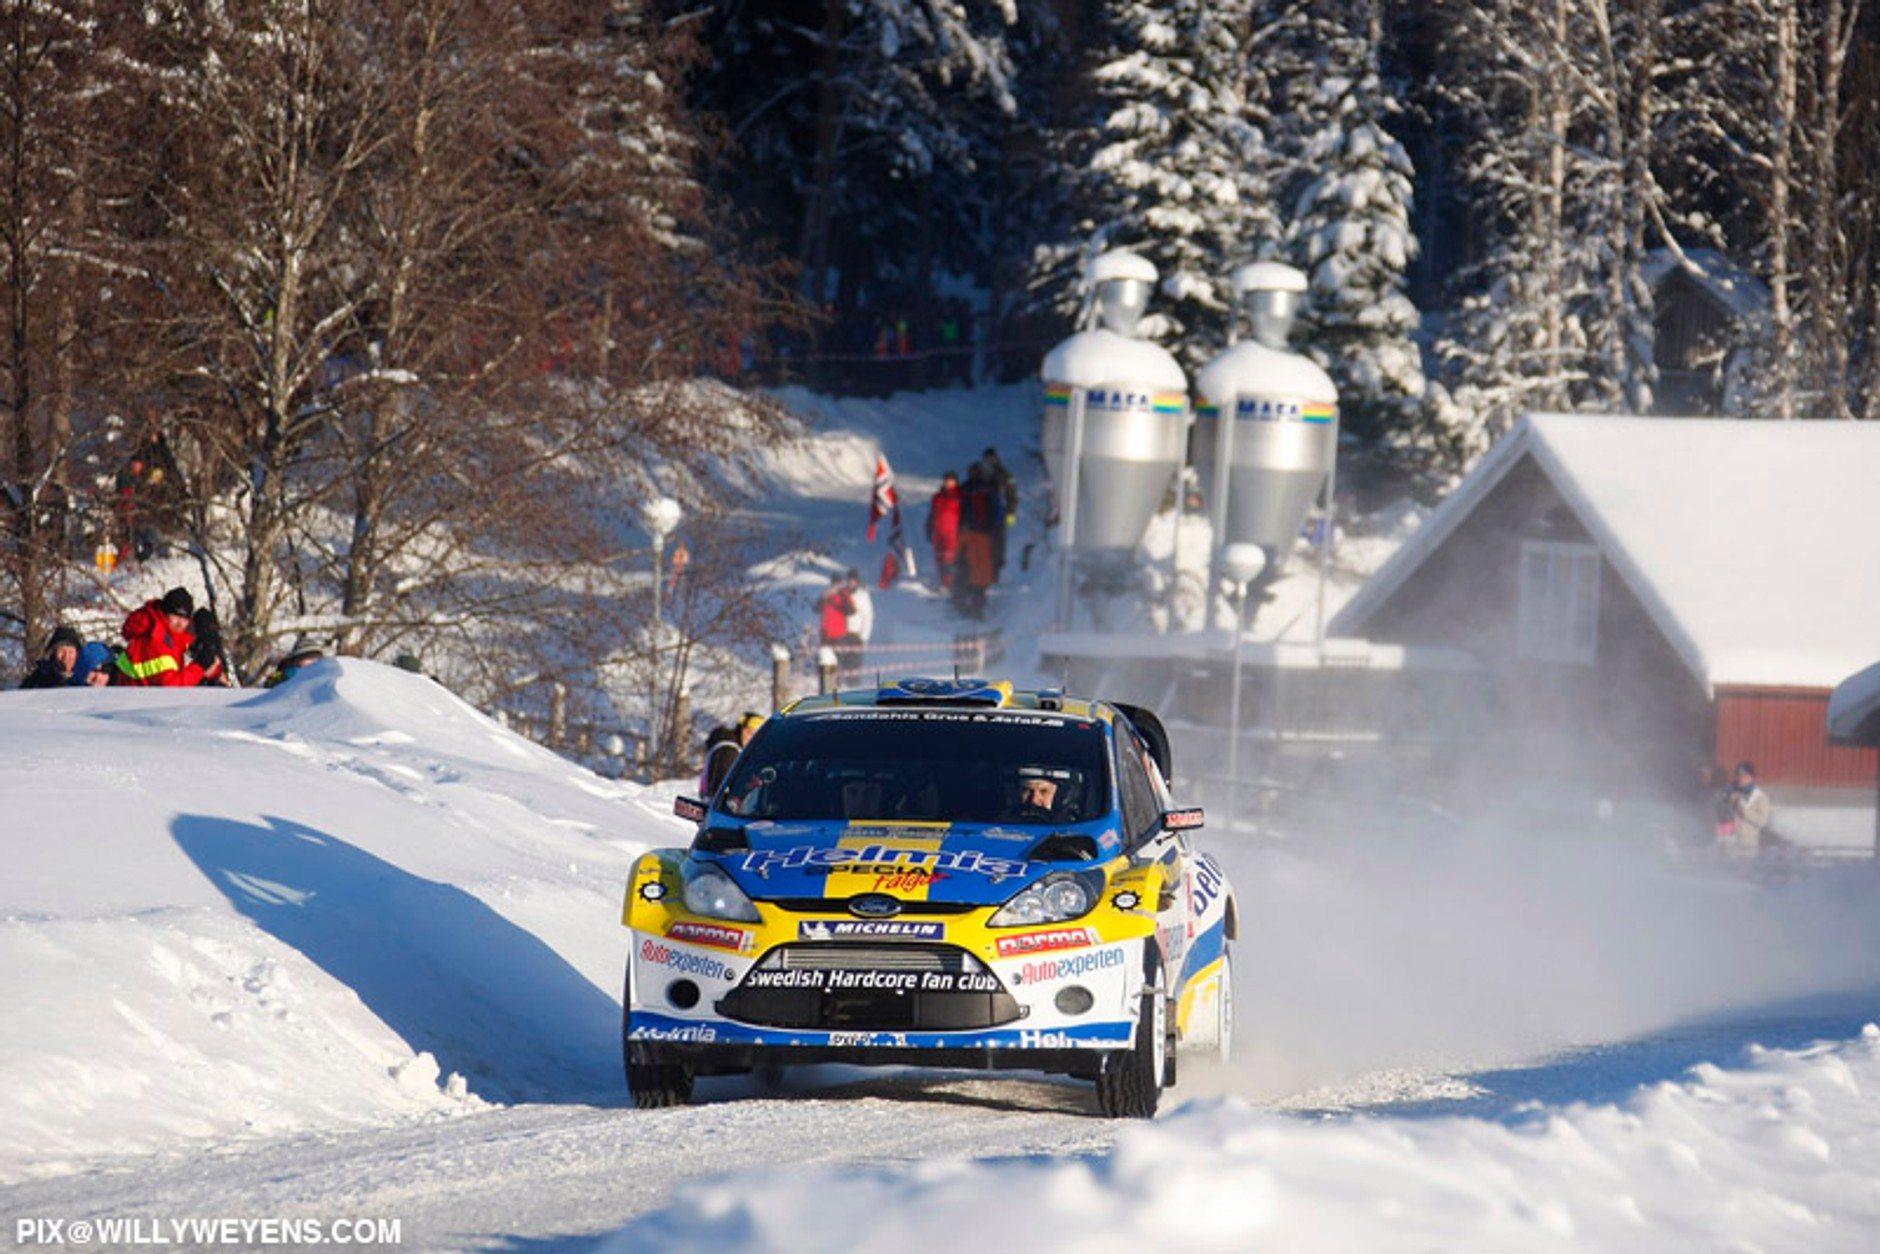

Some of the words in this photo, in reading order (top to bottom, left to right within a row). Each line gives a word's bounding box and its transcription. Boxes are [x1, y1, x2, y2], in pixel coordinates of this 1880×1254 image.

[742, 845, 1028, 877] Helmia
[671, 923, 740, 944] norma
[834, 922, 937, 935] MICHELIN
[999, 929, 1089, 954] norma
[640, 939, 725, 979] Autoexperten
[1022, 948, 1124, 985] Autoexperten
[747, 969, 823, 987] Swedish
[828, 970, 917, 988] Hardcore
[921, 971, 953, 989] fan
